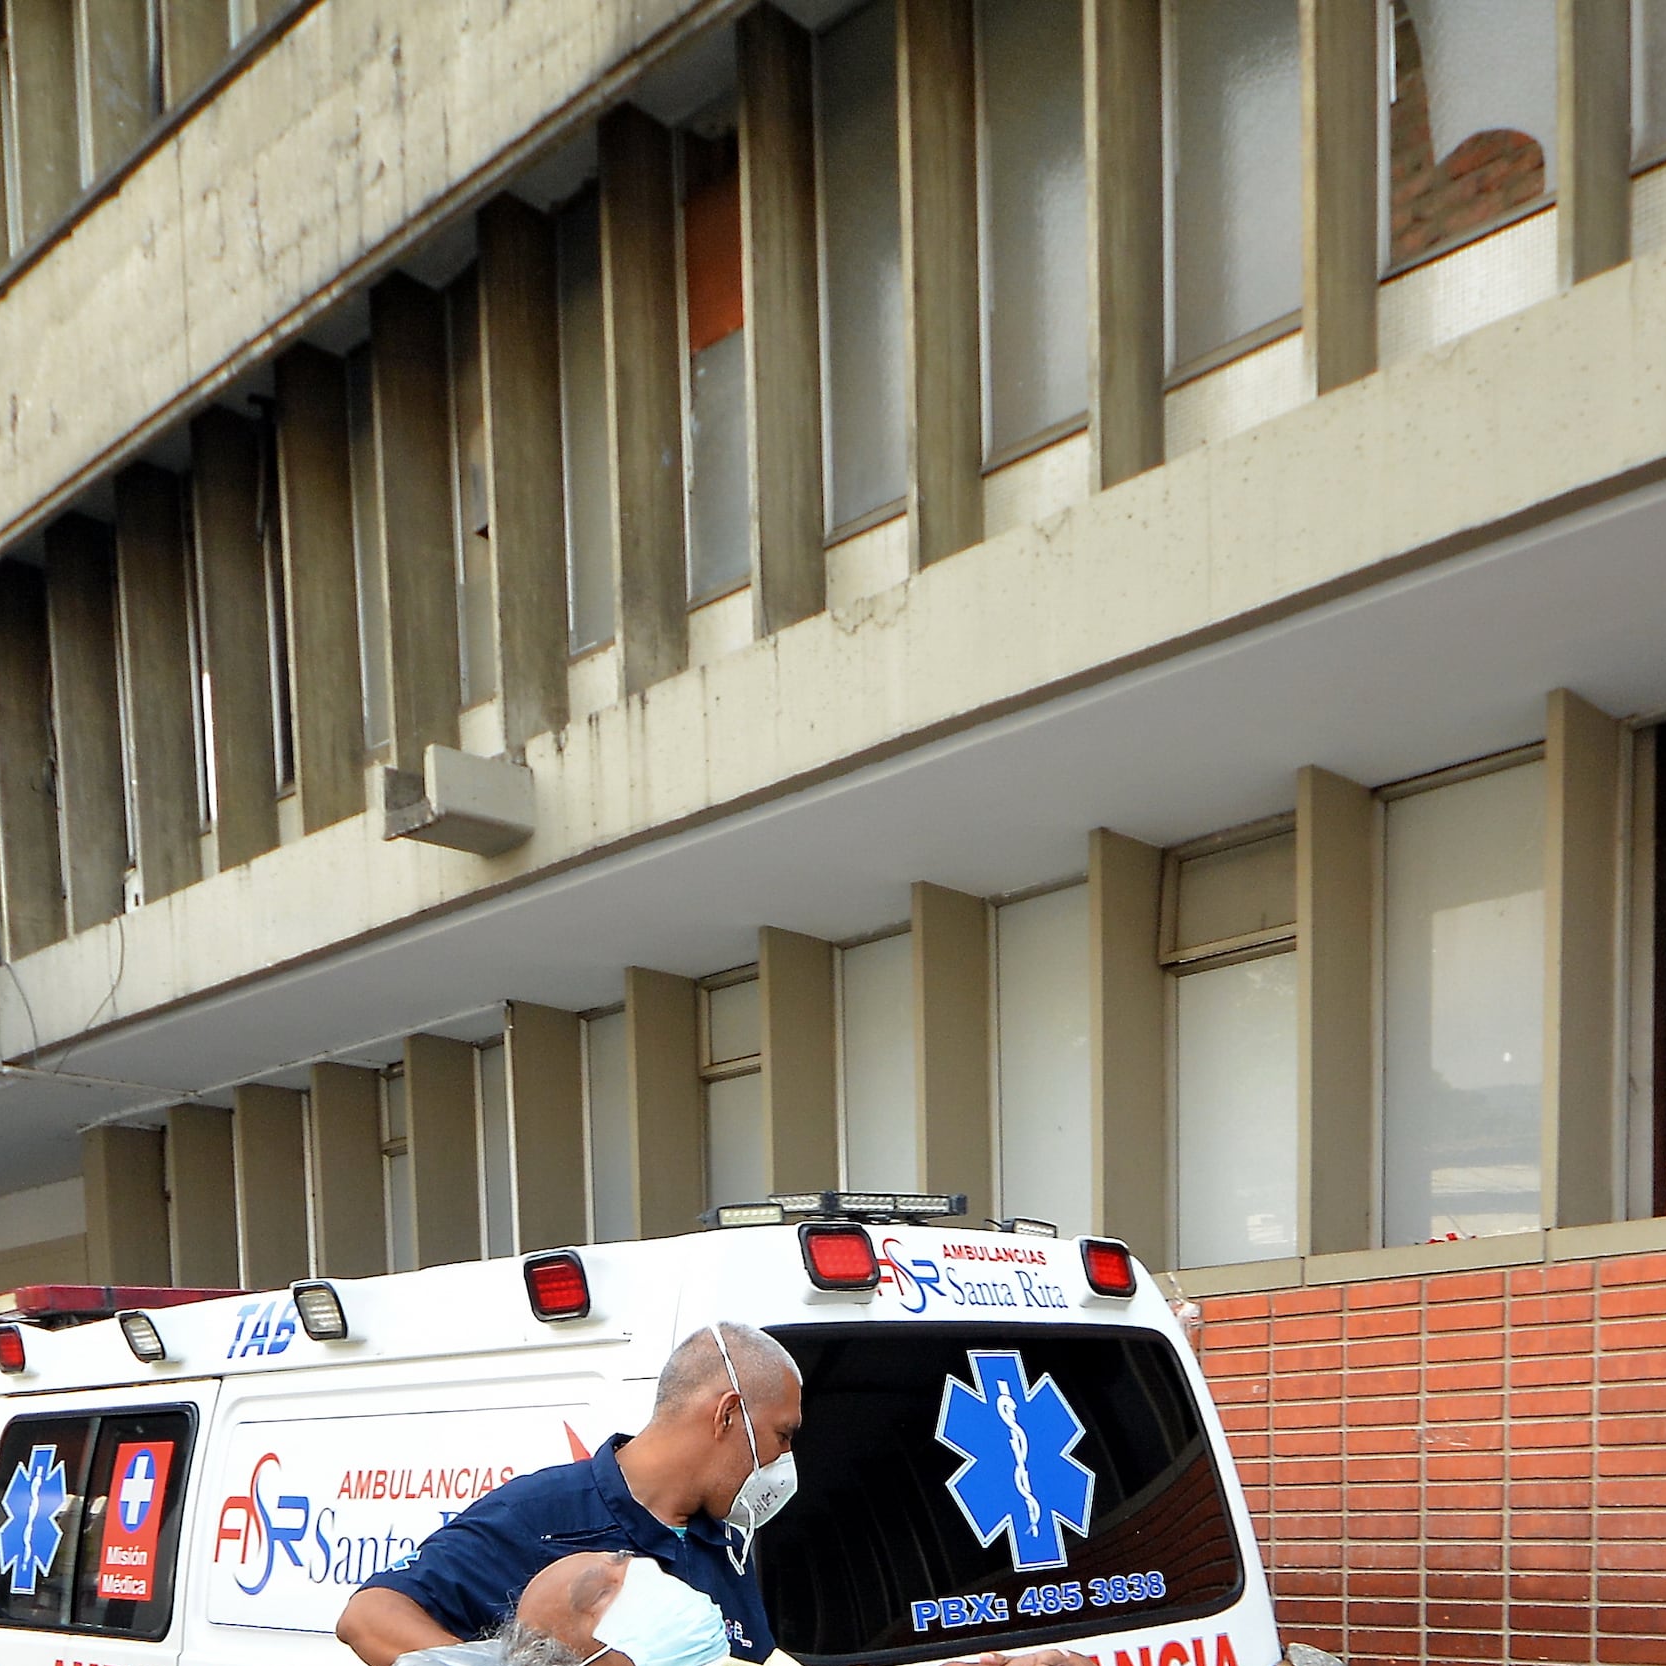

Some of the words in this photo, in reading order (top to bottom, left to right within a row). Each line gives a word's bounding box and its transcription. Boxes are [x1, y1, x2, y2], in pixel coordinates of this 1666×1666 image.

[943, 1244, 1046, 1265] AMBULANCIAS
[946, 1267, 1017, 1306] Santa
[1015, 1271, 1068, 1308] Rita
[227, 1299, 300, 1359] TAB
[106, 1546, 148, 1565] Misión
[102, 1574, 147, 1594] Médica
[910, 1592, 1010, 1632] PBX:
[1017, 1581, 1083, 1616] 485
[1088, 1571, 1166, 1606] 3838
